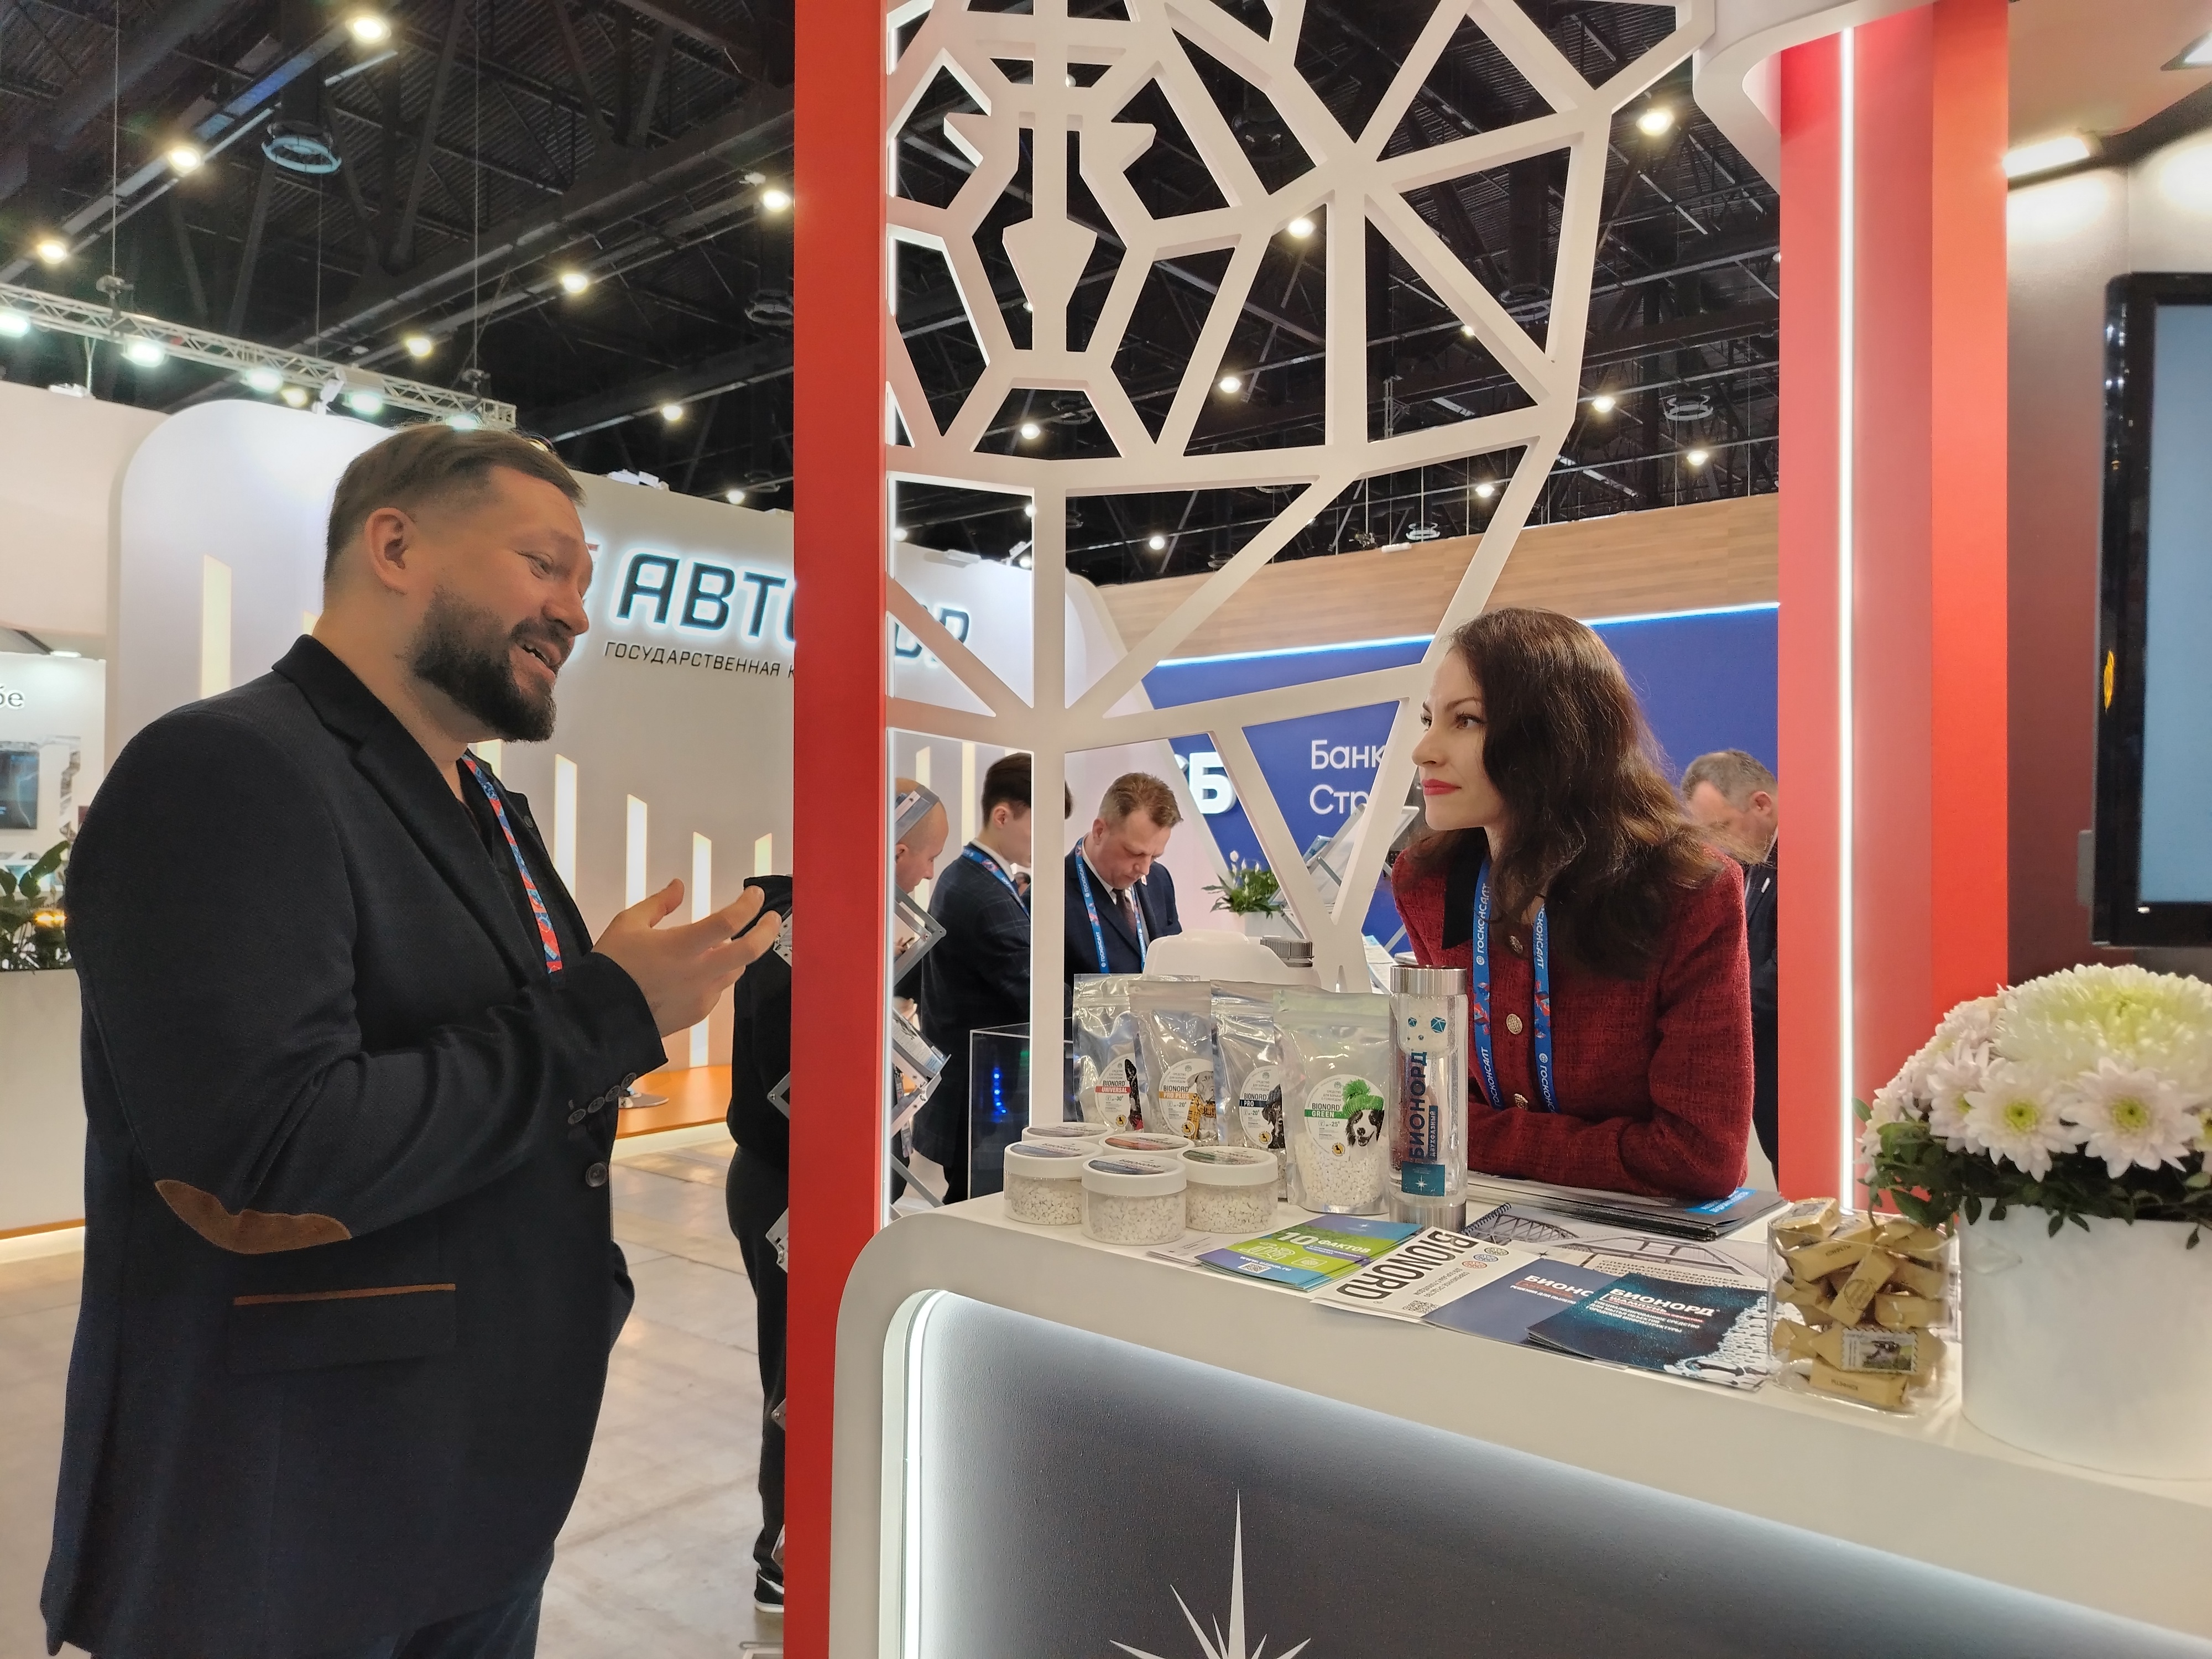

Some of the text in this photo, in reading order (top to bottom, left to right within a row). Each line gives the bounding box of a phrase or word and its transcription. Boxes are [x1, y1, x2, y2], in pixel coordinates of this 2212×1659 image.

[604, 641, 780, 677] ГОСУДАРСТВЕННАЯ
[1310, 784, 1369, 816] Стр
[1477, 883, 1490, 953] ГОСКОНСАЛТ
[1095, 932, 1105, 962] ГОСКОНСАЛТ
[1481, 1046, 1501, 1107] ГОСКОНСАЛТ
[1540, 1065, 1555, 1112] ГОСКОНС
[1410, 1051, 1427, 1160] БИОНОРД
[1277, 1232, 1371, 1253] 10 ФАКТОВ
[1336, 1230, 1479, 1300] BIONORD
[1609, 1288, 1715, 1317] БИОНОРД
[1610, 1296, 1667, 1313] ШАМПУНЬ
